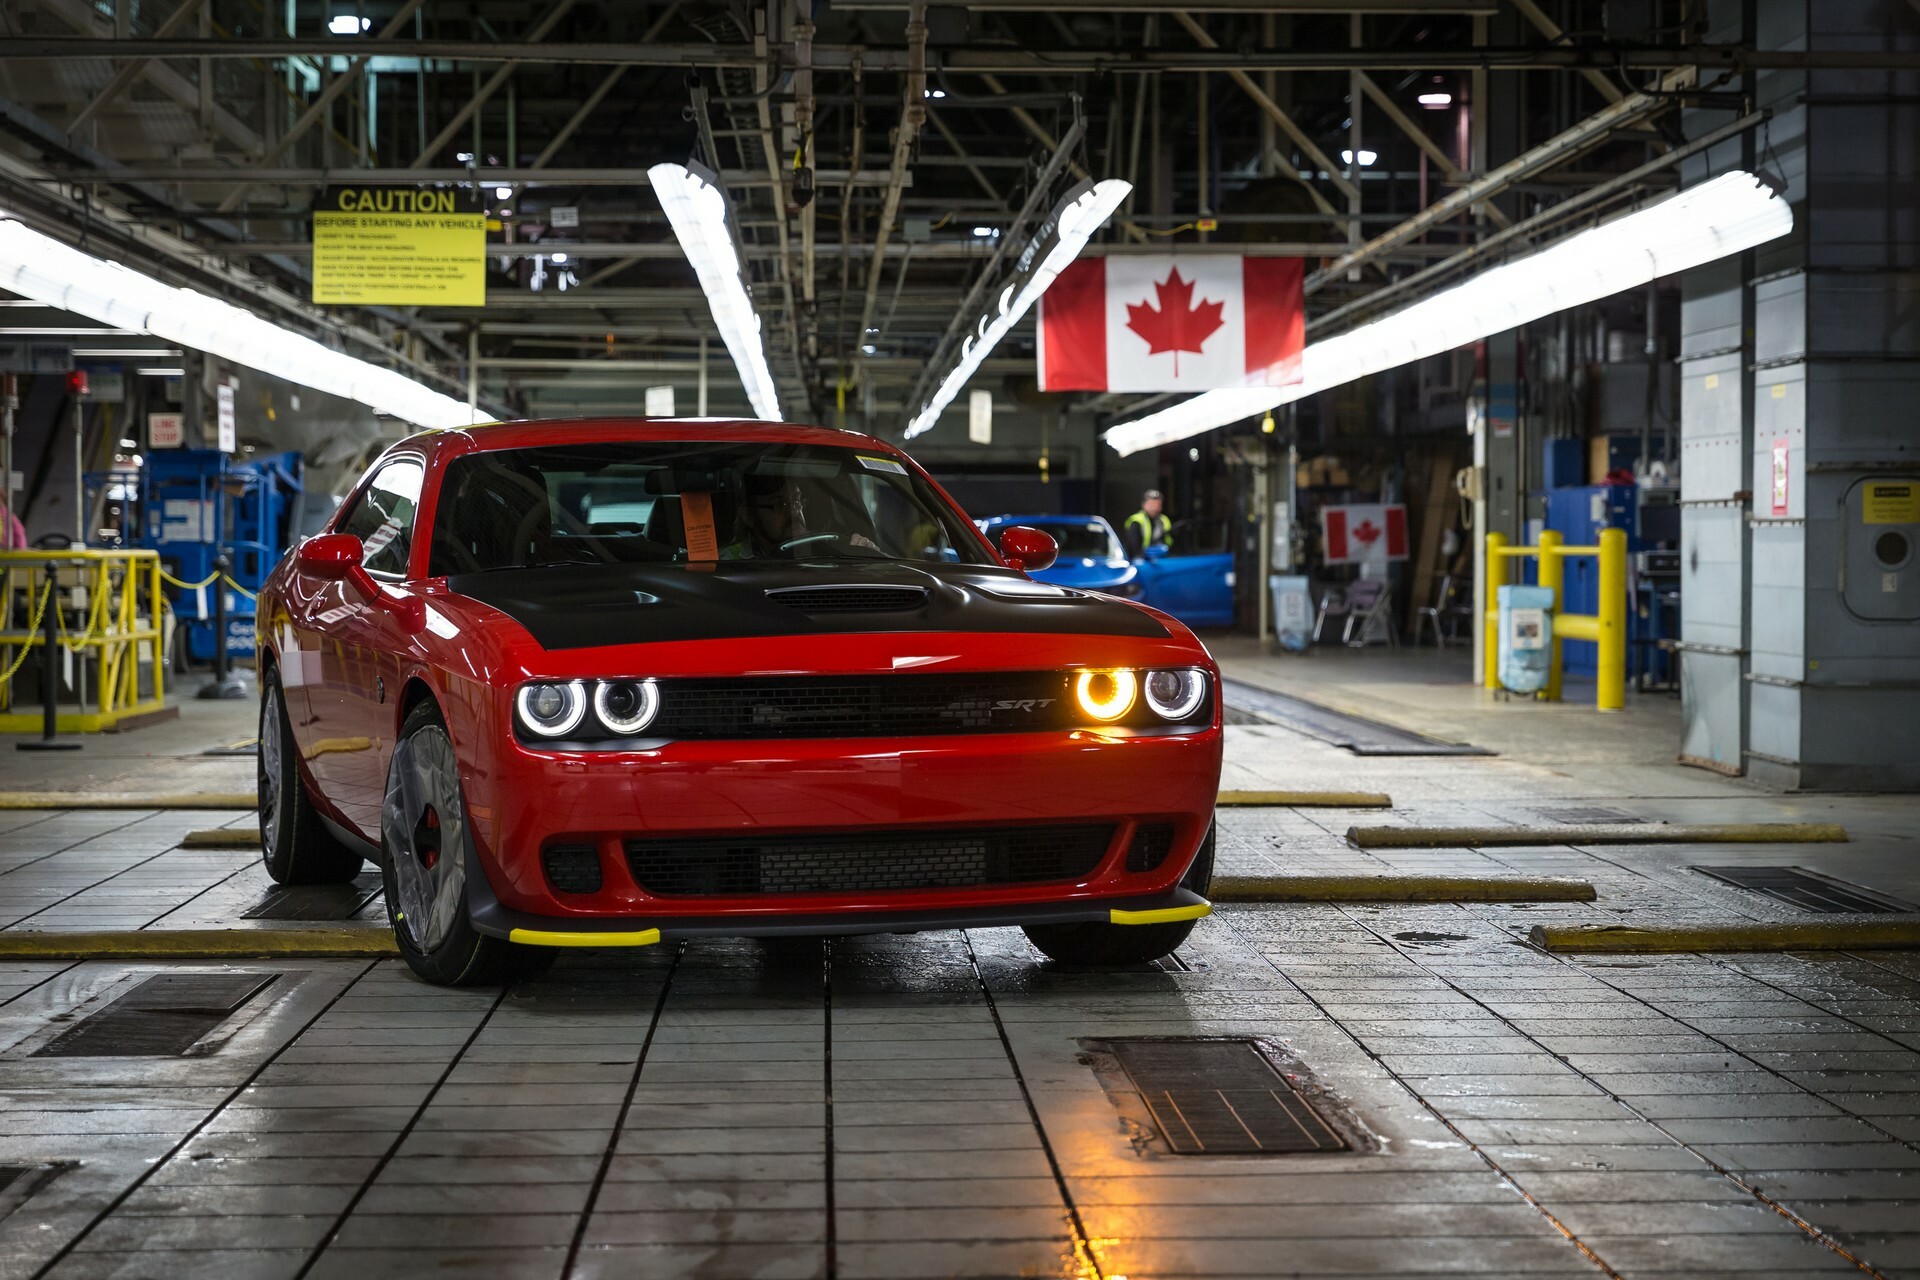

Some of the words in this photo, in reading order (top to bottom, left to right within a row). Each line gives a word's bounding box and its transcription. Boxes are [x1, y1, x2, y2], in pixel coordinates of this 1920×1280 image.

[339, 190, 455, 212] CAUTION
[315, 217, 358, 228] BEFORE
[360, 217, 412, 229] STARTING
[414, 218, 436, 229] ANY
[439, 219, 484, 231] VEHICLE
[991, 698, 1057, 712] SRT
